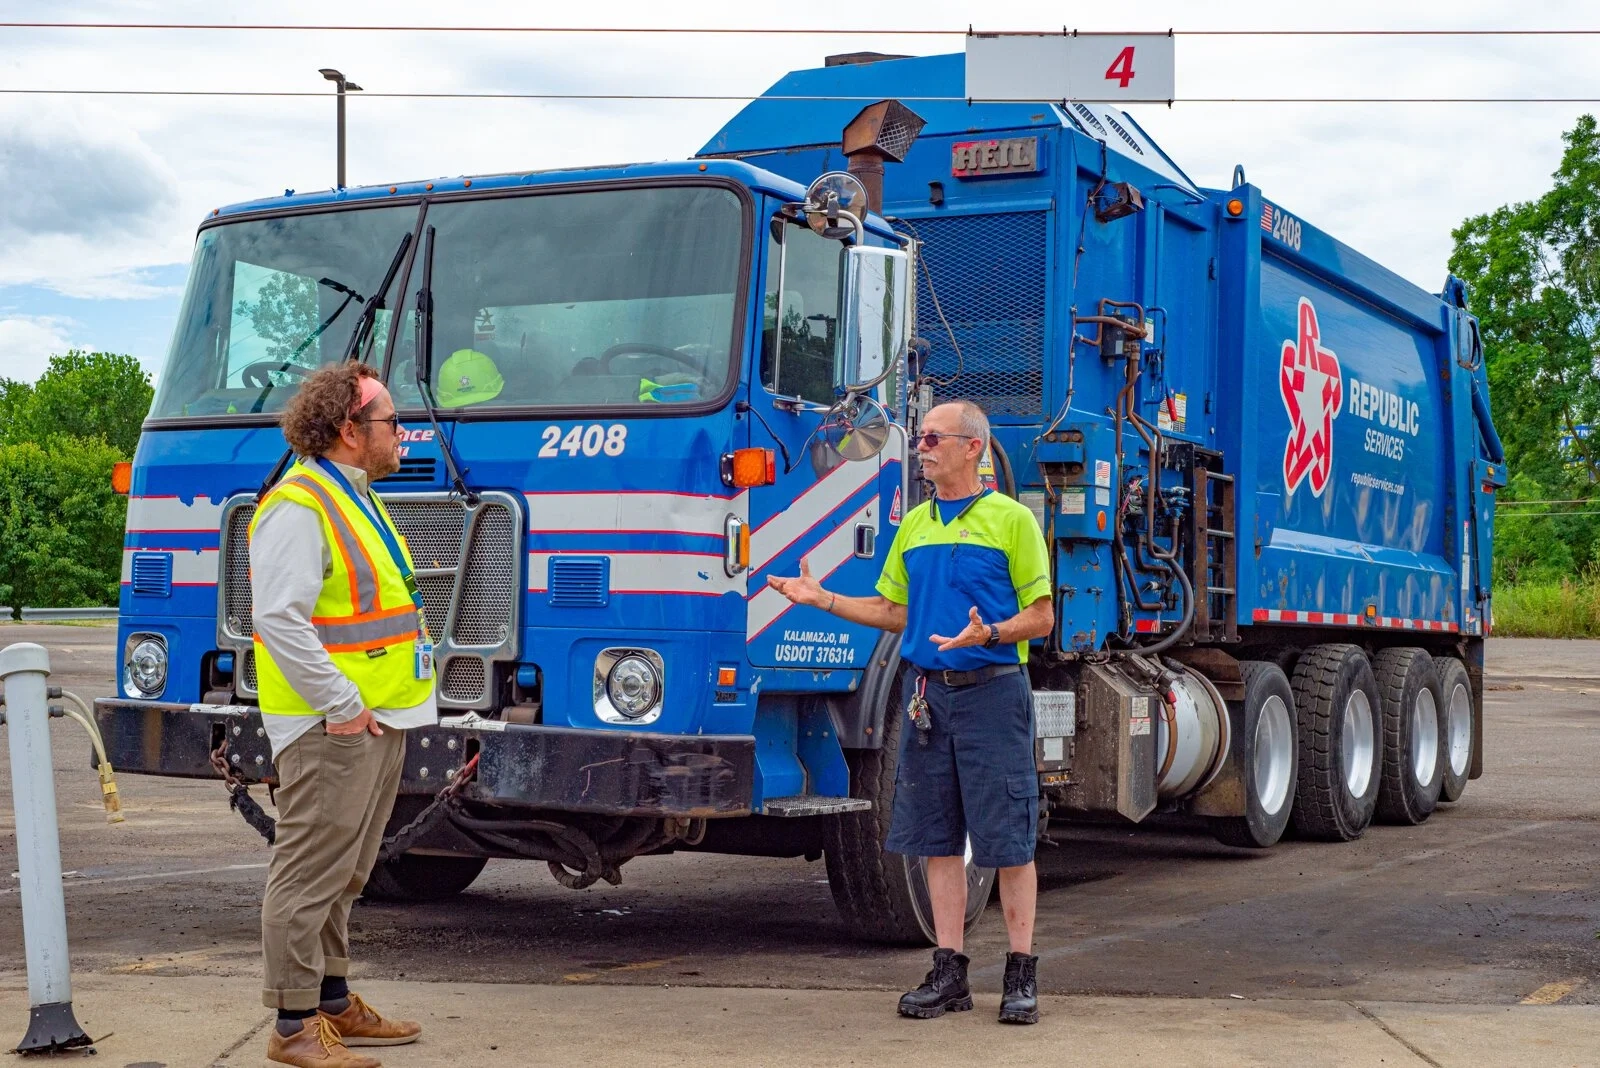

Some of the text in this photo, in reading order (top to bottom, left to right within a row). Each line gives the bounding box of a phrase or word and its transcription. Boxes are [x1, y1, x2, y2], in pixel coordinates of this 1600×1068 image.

[1104, 46, 1136, 88] 4
[955, 143, 1031, 170] HEIL
[1272, 208, 1302, 251] 2408
[1349, 378, 1419, 437] REPUBLIC
[538, 423, 628, 458] 2408
[1364, 428, 1405, 461] SERVICES
[1350, 472, 1405, 495] republicservices.com
[775, 645, 854, 663] USDOT 376314
[839, 634, 849, 644] MI
